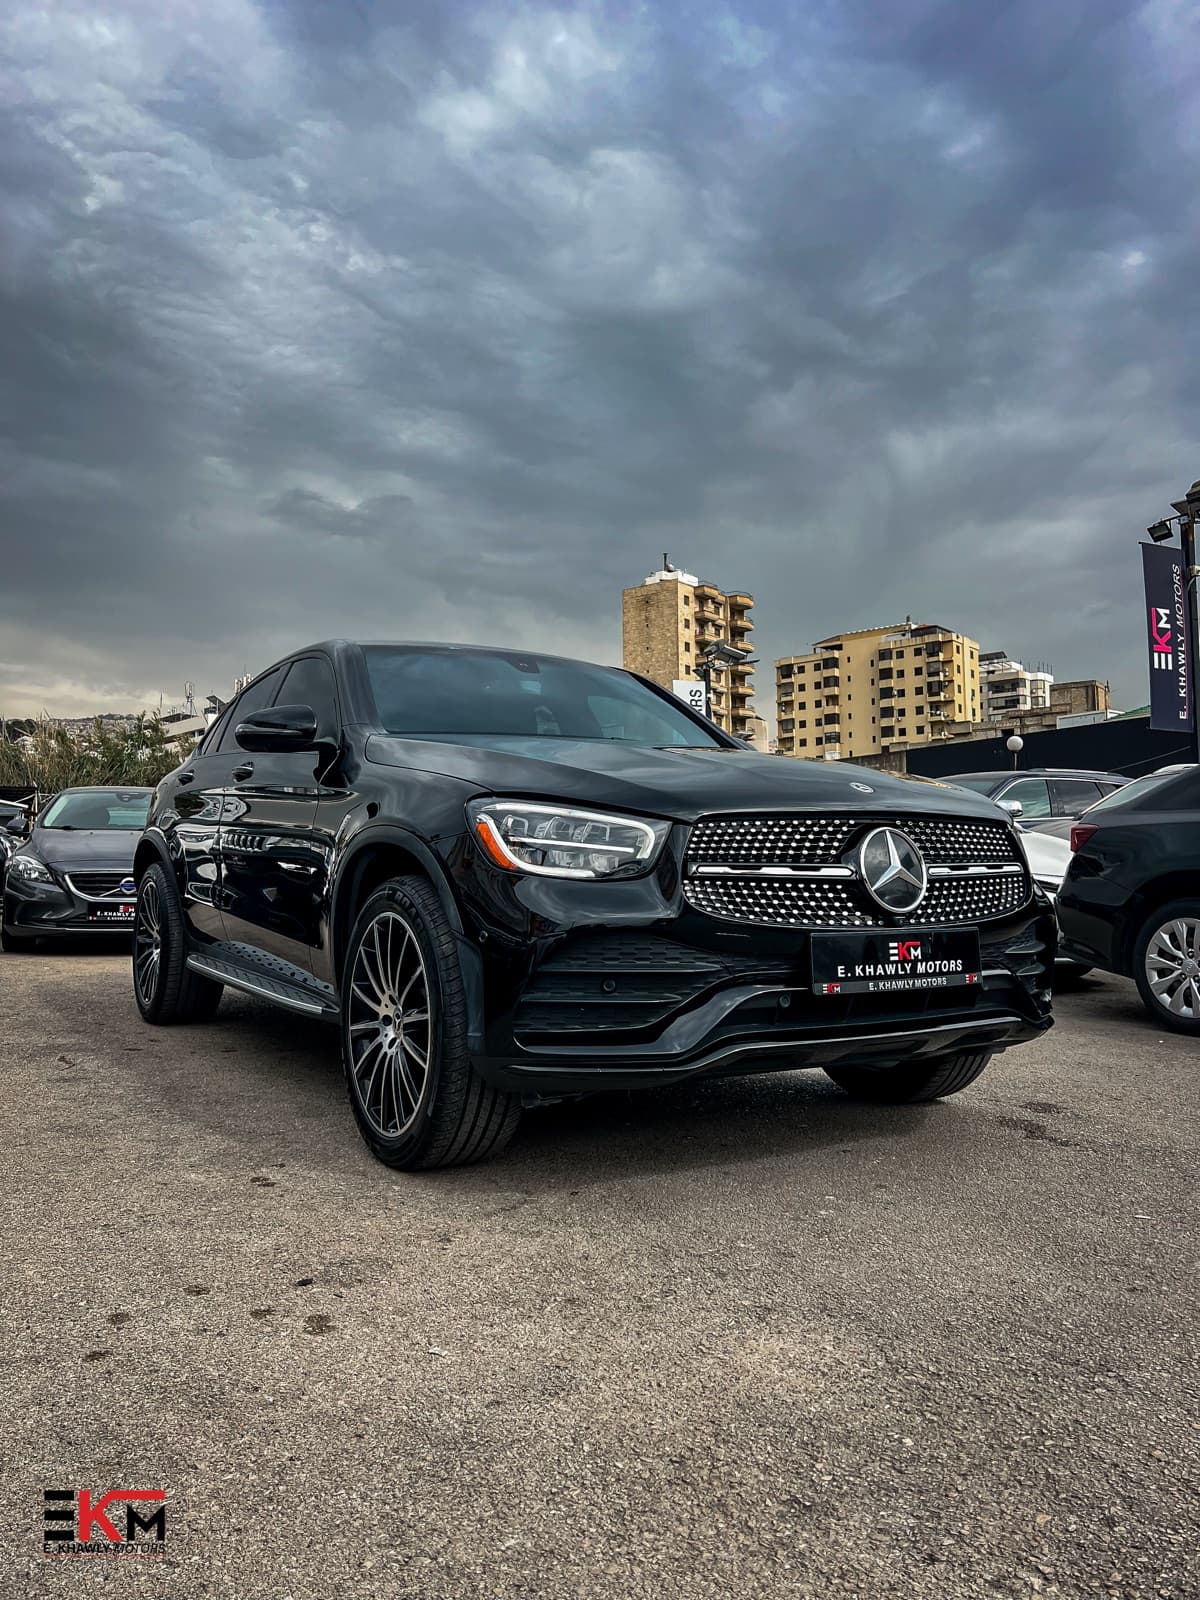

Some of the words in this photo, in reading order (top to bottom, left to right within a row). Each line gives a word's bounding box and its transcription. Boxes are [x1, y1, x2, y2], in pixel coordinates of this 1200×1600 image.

[1172, 564, 1184, 627] MOTORS
[1177, 633, 1187, 697] KHAWLY
[1179, 705, 1187, 720] E.
[888, 941, 922, 961] EKM
[837, 965, 852, 978] E.
[855, 963, 912, 977] KHAWLY
[916, 960, 963, 974] MOTORS
[868, 982, 878, 991] E.
[879, 980, 914, 991] KHAWLY
[914, 977, 947, 987] MOTORS
